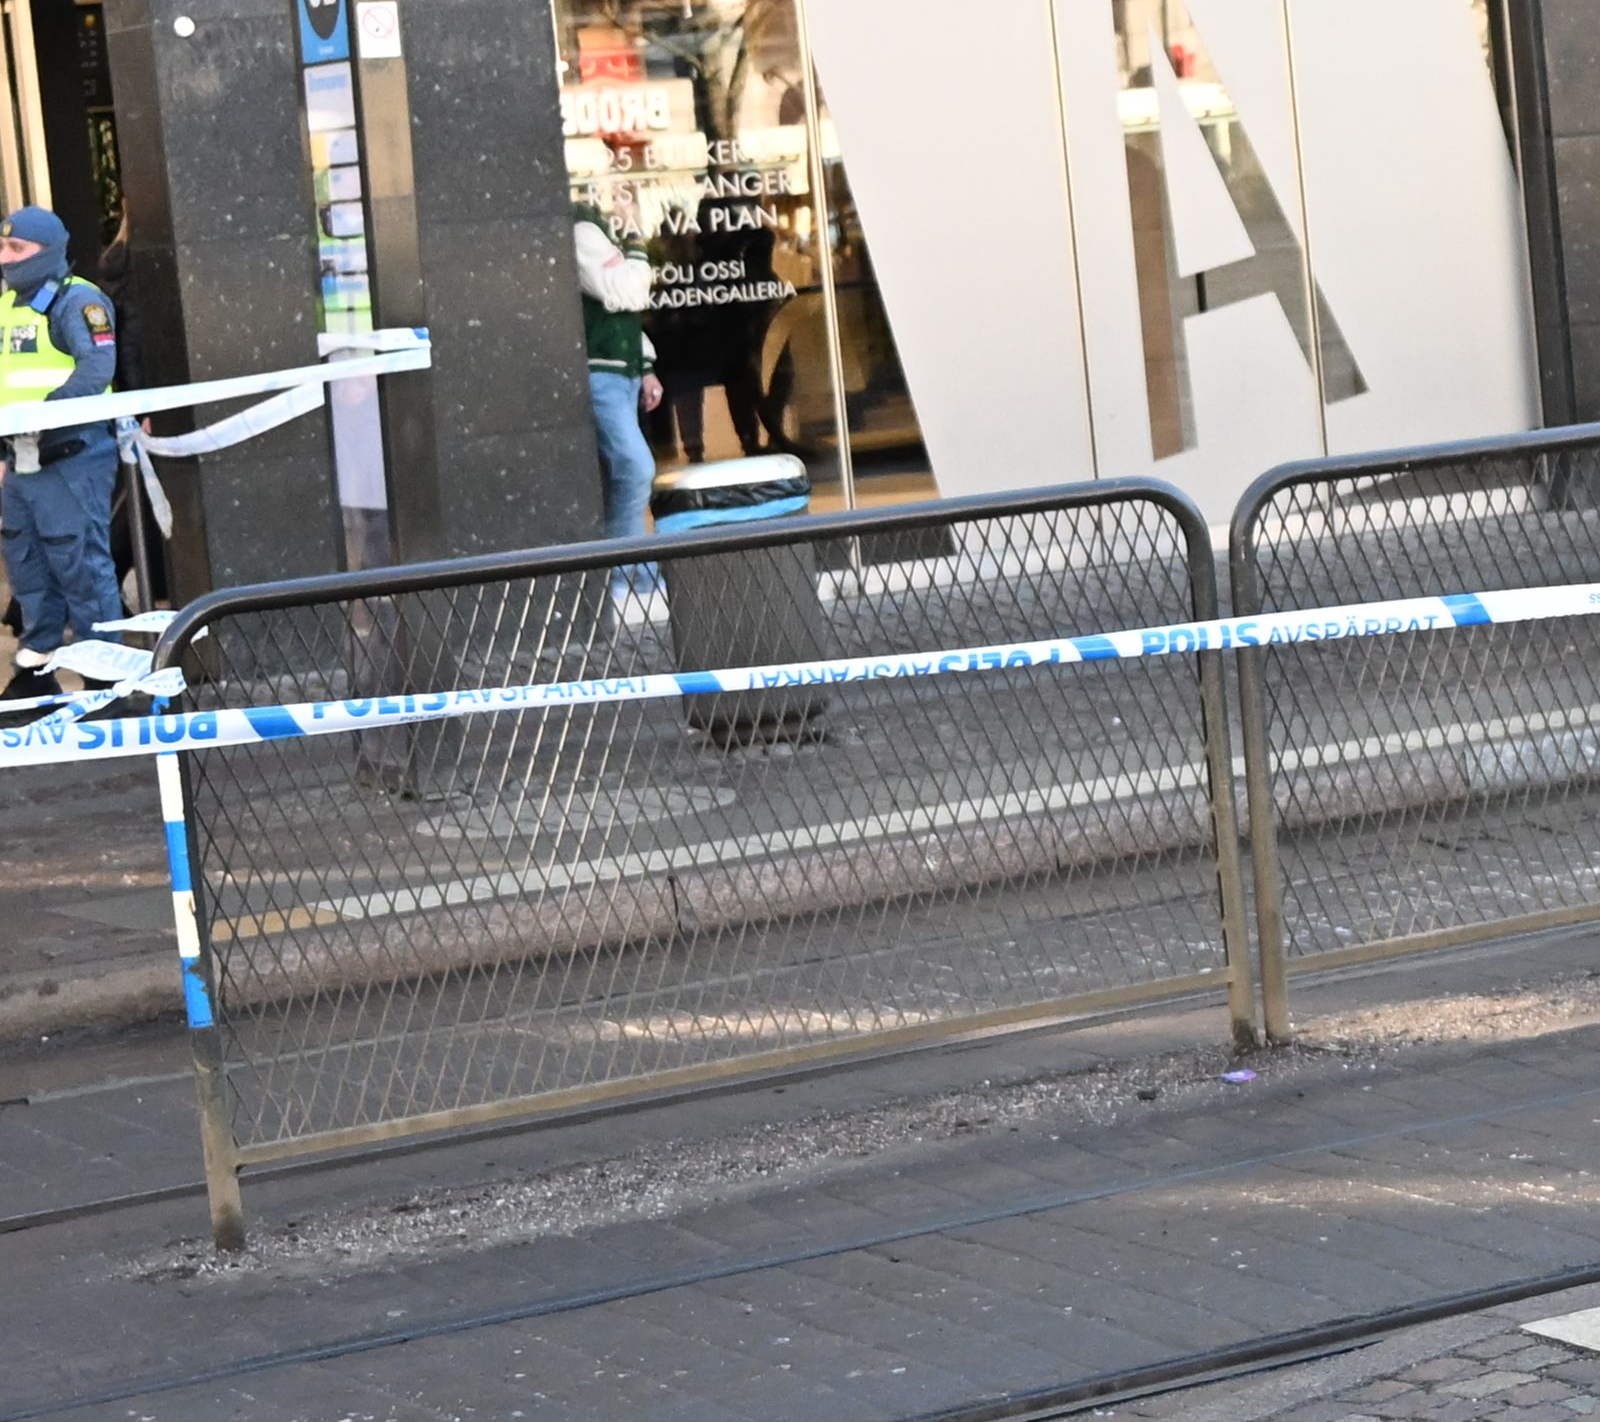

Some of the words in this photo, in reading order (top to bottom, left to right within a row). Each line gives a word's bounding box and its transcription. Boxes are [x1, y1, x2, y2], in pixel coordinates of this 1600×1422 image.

[710, 205, 778, 230] PLAN
[1141, 622, 1260, 656] POLIS
[78, 710, 218, 750] POLIS
